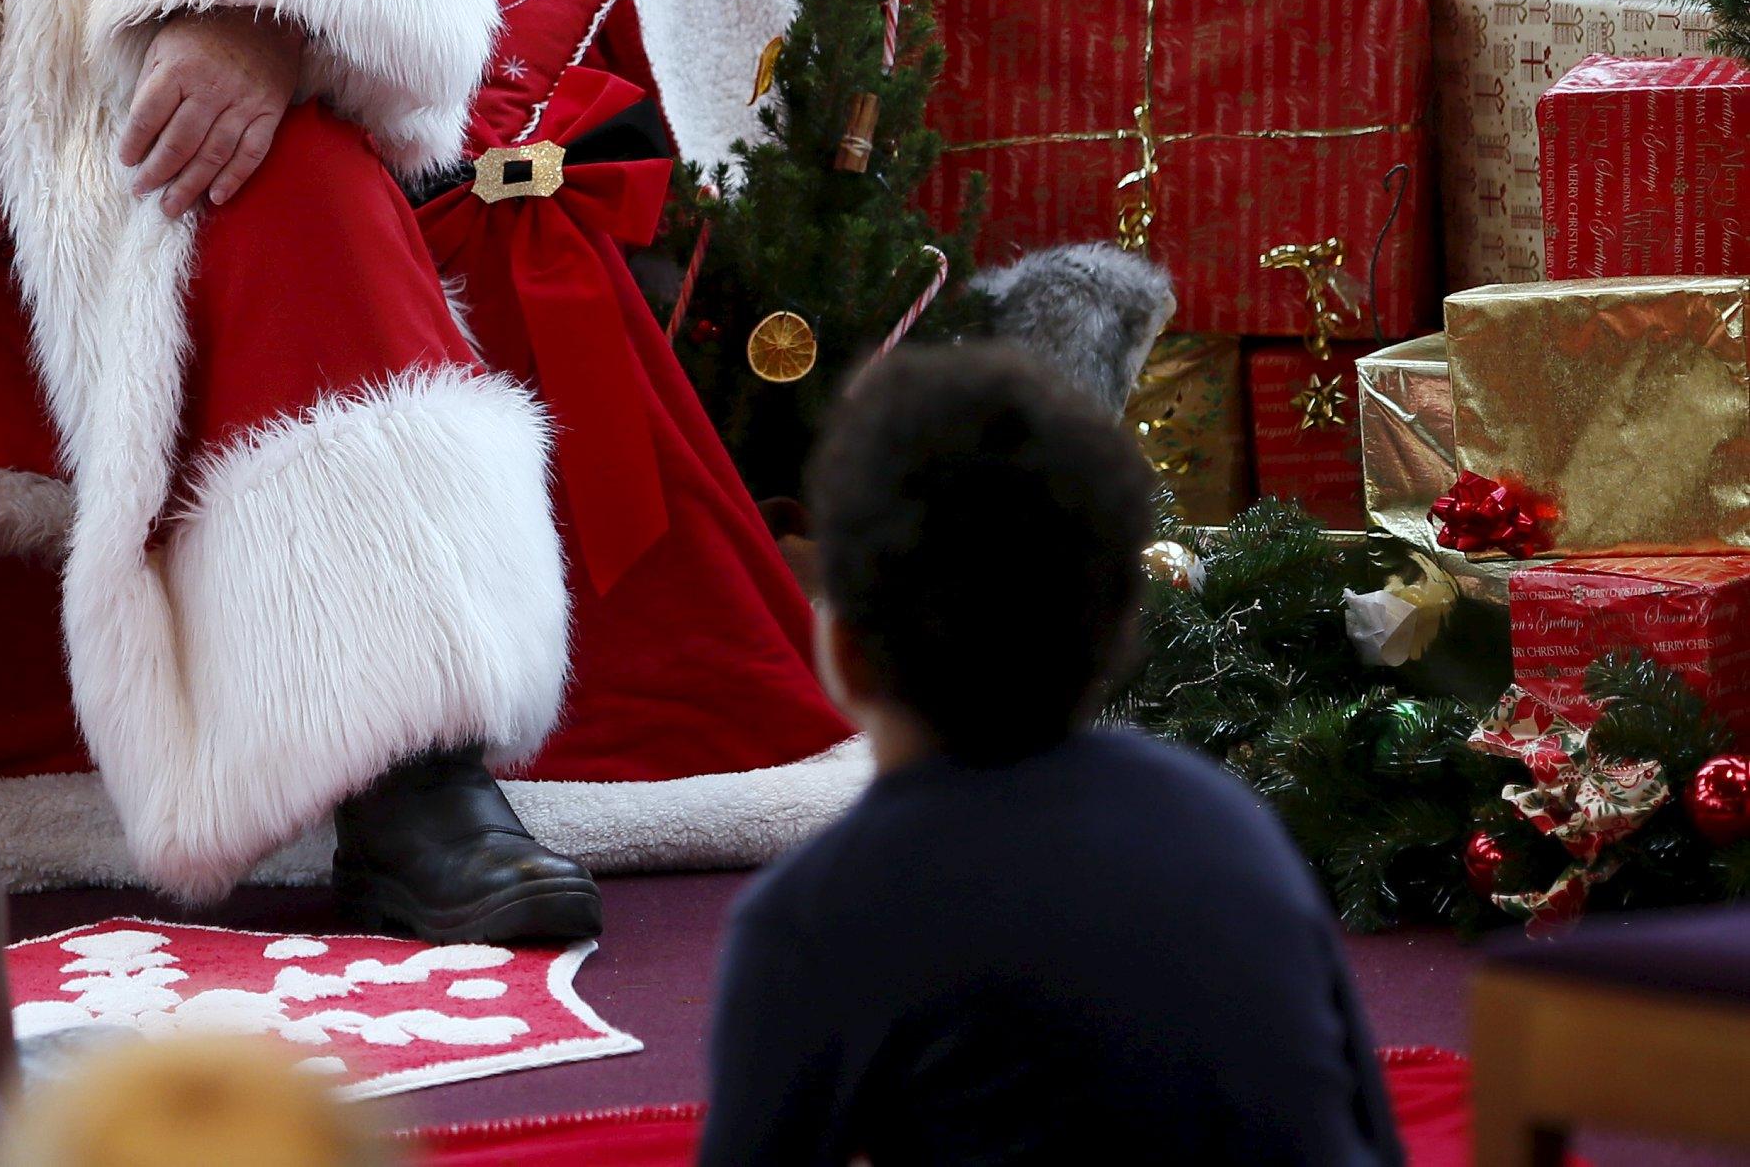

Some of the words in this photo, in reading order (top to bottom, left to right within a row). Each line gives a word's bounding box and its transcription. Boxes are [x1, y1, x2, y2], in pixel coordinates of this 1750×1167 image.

[1592, 93, 1617, 149] Merry
[1621, 95, 1632, 137] CHRISTMAS
[1674, 94, 1685, 123] MERRY
[1545, 138, 1555, 168] MERRY
[1621, 141, 1632, 165] MERRY
[1640, 132, 1669, 192] Greetings
[1674, 124, 1685, 176] CHRISTMAS
[1567, 163, 1579, 199] MERRY
[1593, 157, 1614, 217] Season's
[1621, 166, 1632, 213] CHRISTMAS
[1695, 129, 1724, 218] Christmas
[1718, 149, 1744, 206] Merry
[1545, 169, 1555, 223] CHRISTMAS
[1674, 196, 1685, 224] MERRY
[1544, 241, 1555, 269] MERRY
[1567, 201, 1579, 270] CHRISTMAS
[1621, 211, 1643, 269] Wishes
[1694, 222, 1706, 259] MERRY
[1529, 590, 1571, 601] CHRISTMAS
[1585, 589, 1609, 599] MERRY
[1609, 586, 1651, 599] CHRISTMAS
[1536, 606, 1585, 637] Greetings
[1526, 645, 1580, 659] CHRISTMAS
[1653, 641, 1686, 653] MERRY
